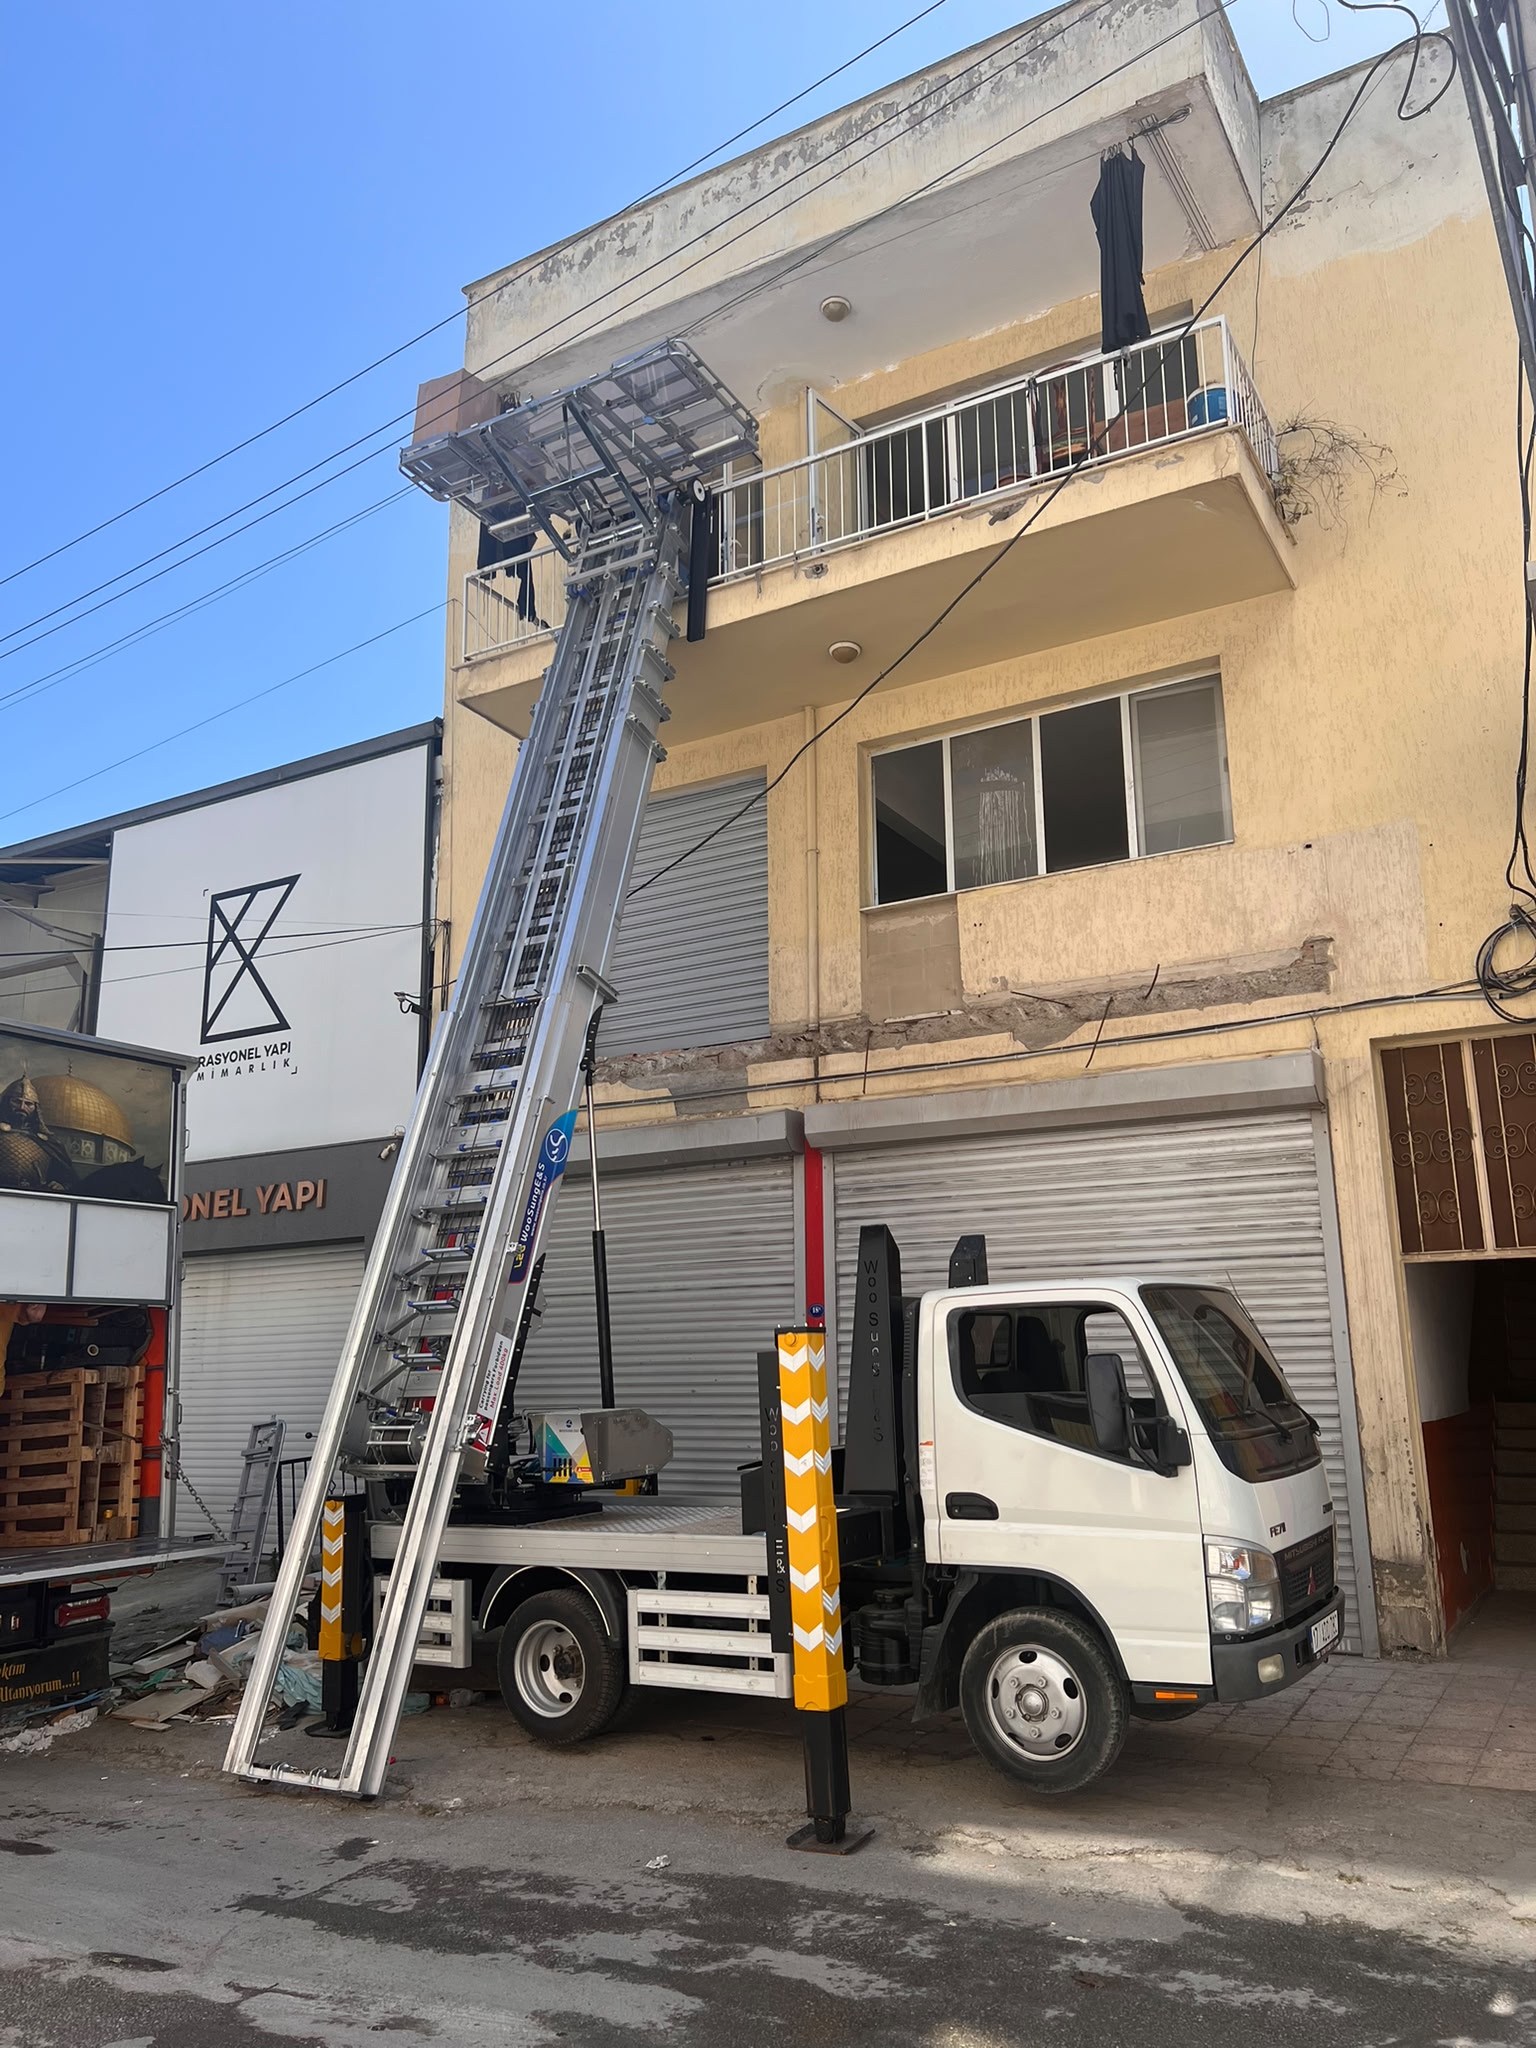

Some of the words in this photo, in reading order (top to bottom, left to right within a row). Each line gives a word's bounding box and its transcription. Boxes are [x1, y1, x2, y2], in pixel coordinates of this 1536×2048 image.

[199, 1047, 261, 1067] RASYONEL
[264, 1041, 291, 1057] YAPI
[196, 1058, 290, 1081] MİMARLIK
[255, 1179, 326, 1213] YAPI
